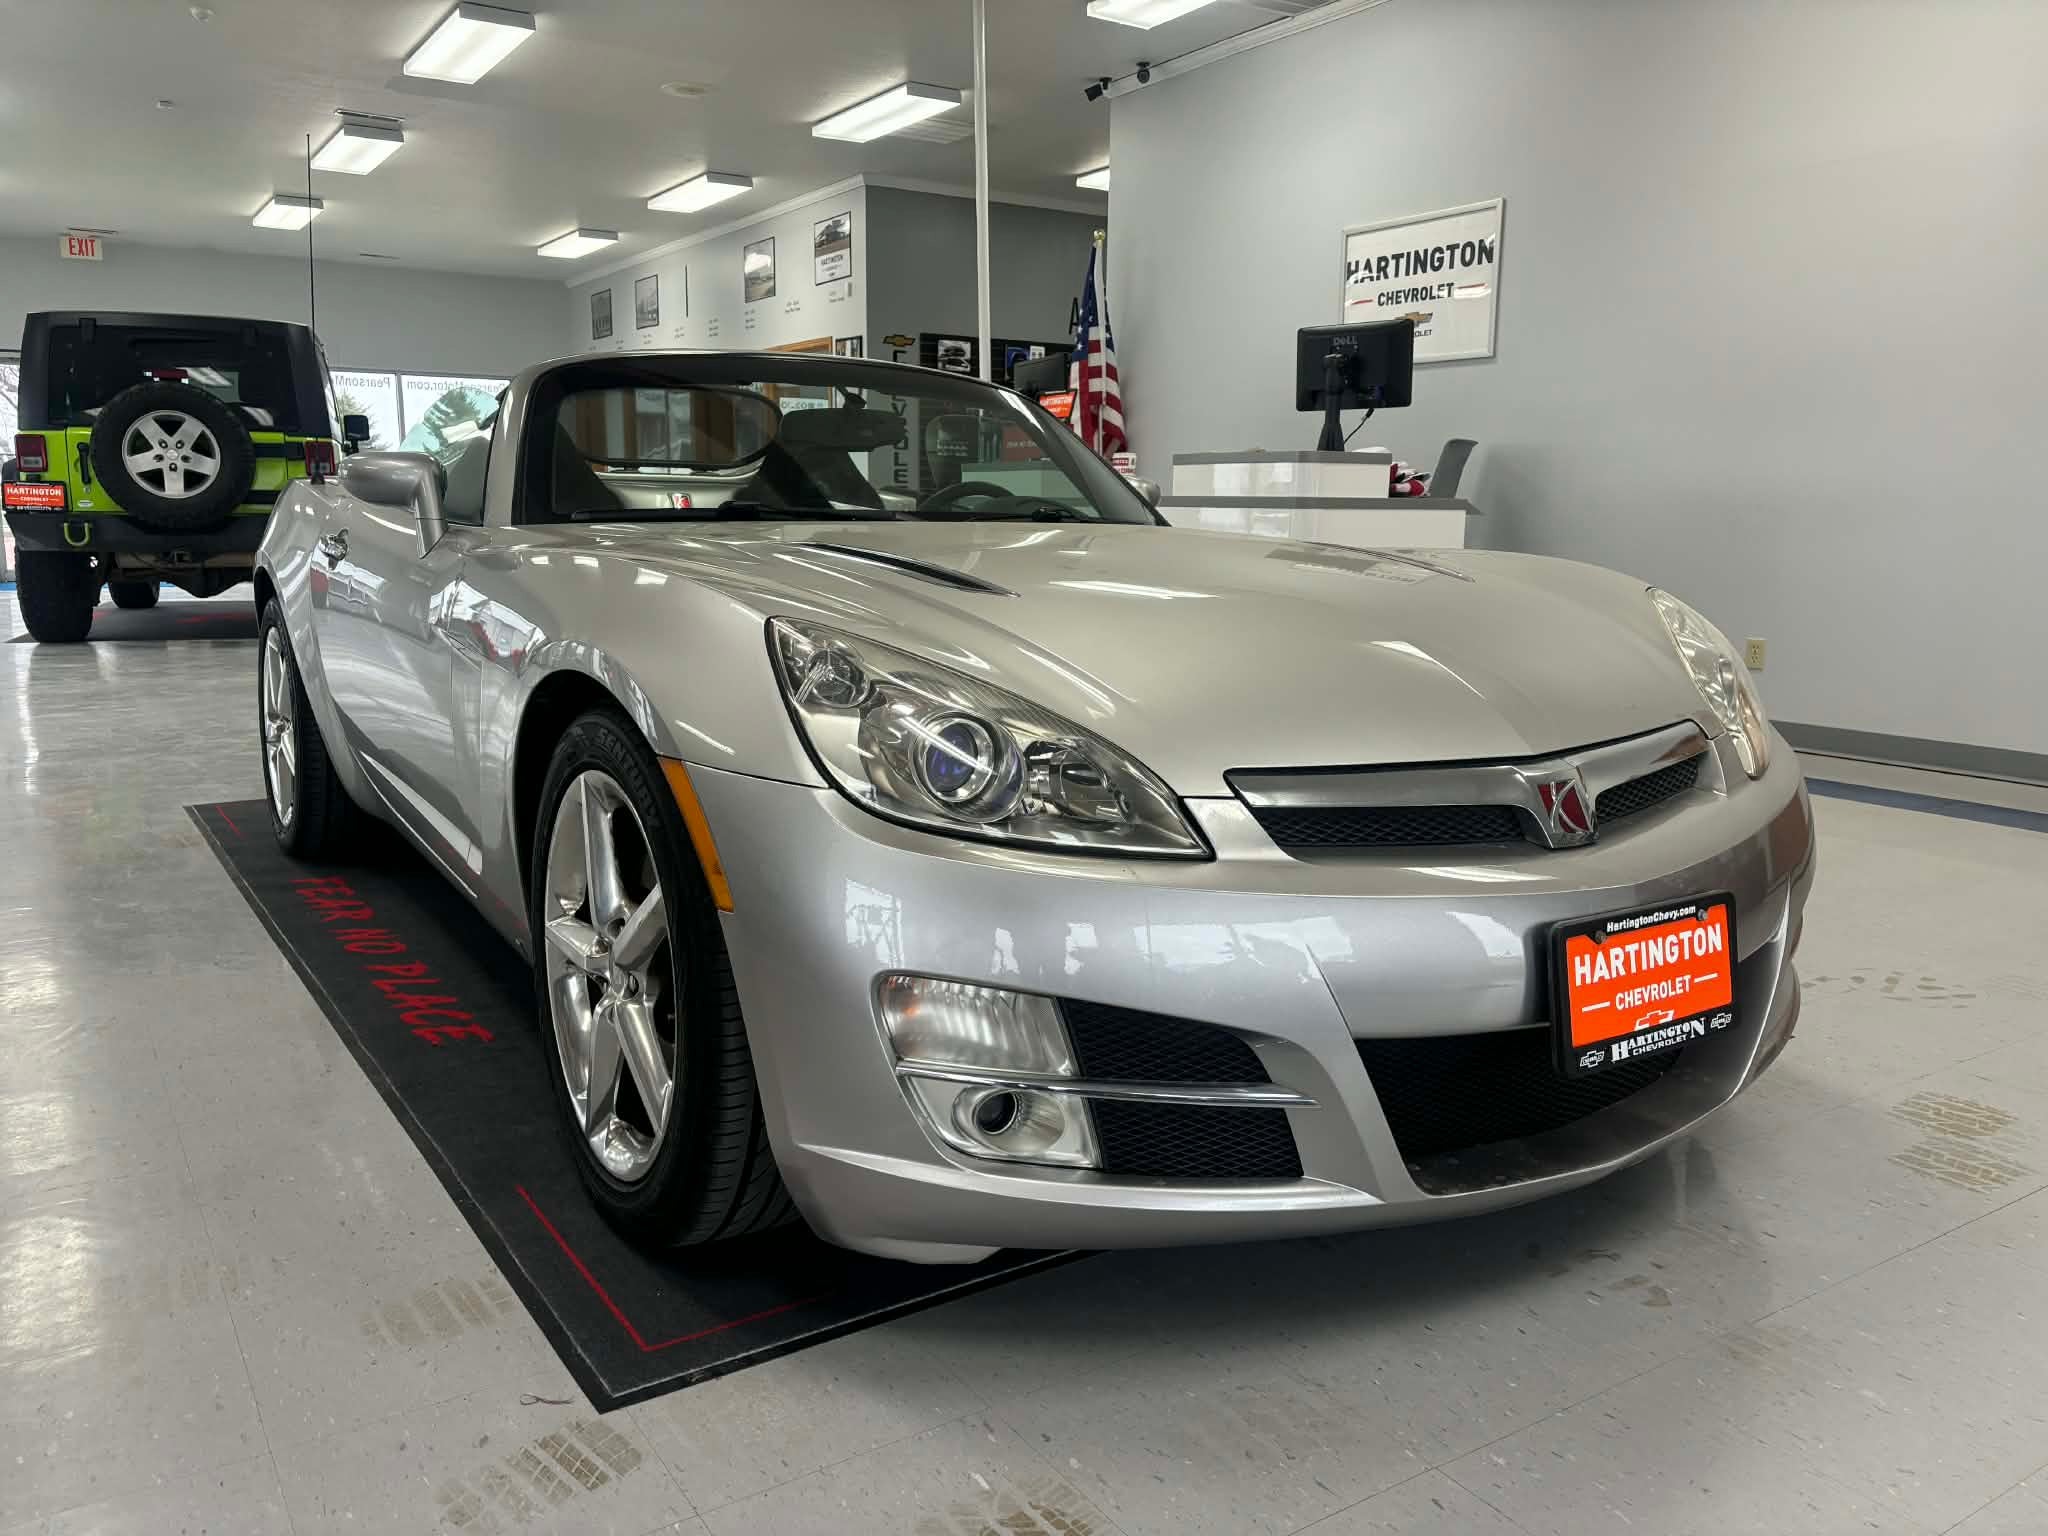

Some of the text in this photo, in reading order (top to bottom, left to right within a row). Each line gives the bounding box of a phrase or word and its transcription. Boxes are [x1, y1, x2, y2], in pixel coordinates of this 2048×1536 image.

[68, 237, 95, 257] EXIT
[1346, 238, 1495, 285] HARTINGTON
[1376, 282, 1455, 307] CHEVROLET
[1332, 335, 1358, 346] DELL
[7, 486, 62, 497] HARTINGTON
[1606, 905, 1696, 933] HartingtonChevy.com
[328, 928, 408, 955] NO
[1573, 922, 1723, 988] HARTINGTON
[358, 960, 497, 1046] PLACE
[1615, 974, 1692, 1010] CHEVROLET
[1611, 1017, 1705, 1063] HARTINGTON
[1632, 1033, 1687, 1056] CHEVROLET
